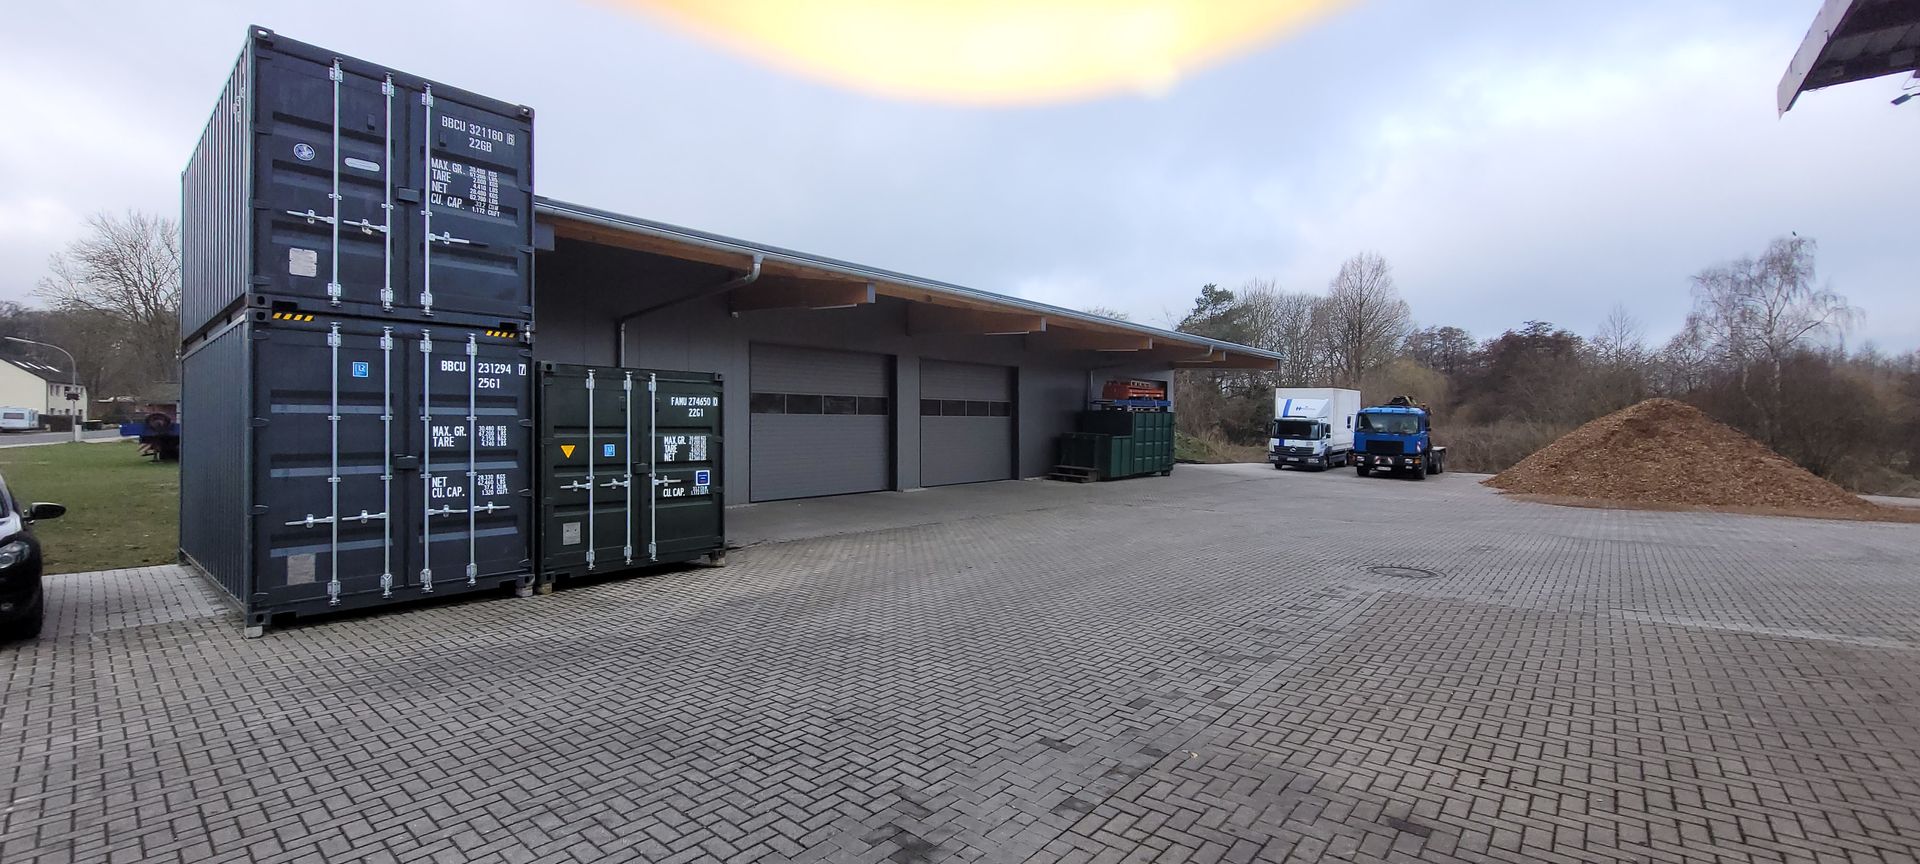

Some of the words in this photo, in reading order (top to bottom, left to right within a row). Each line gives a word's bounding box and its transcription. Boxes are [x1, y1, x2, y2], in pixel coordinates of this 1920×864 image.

[442, 116, 466, 131] BBCU
[469, 124, 503, 141] 321160
[506, 133, 514, 146] 6
[469, 138, 492, 152] 22GB
[431, 158, 451, 171] MAX.
[452, 163, 465, 175] GR.
[432, 169, 451, 182] TARE
[432, 180, 448, 193] NET
[431, 193, 443, 205] CU.
[447, 196, 464, 209] CAP.
[442, 360, 466, 372] BBCU
[478, 363, 511, 374] 231294
[519, 364, 526, 375] 7
[478, 378, 500, 388] 25G1
[688, 397, 711, 406] 274650
[688, 408, 704, 417] 22G1
[433, 426, 451, 436] MAX.
[454, 426, 467, 436] GR.
[433, 436, 455, 447] TARE
[664, 453, 675, 461] NET
[432, 477, 447, 487] NET
[432, 487, 445, 498] CU.
[447, 486, 465, 498] CAP.
[673, 488, 685, 496] CAP.
